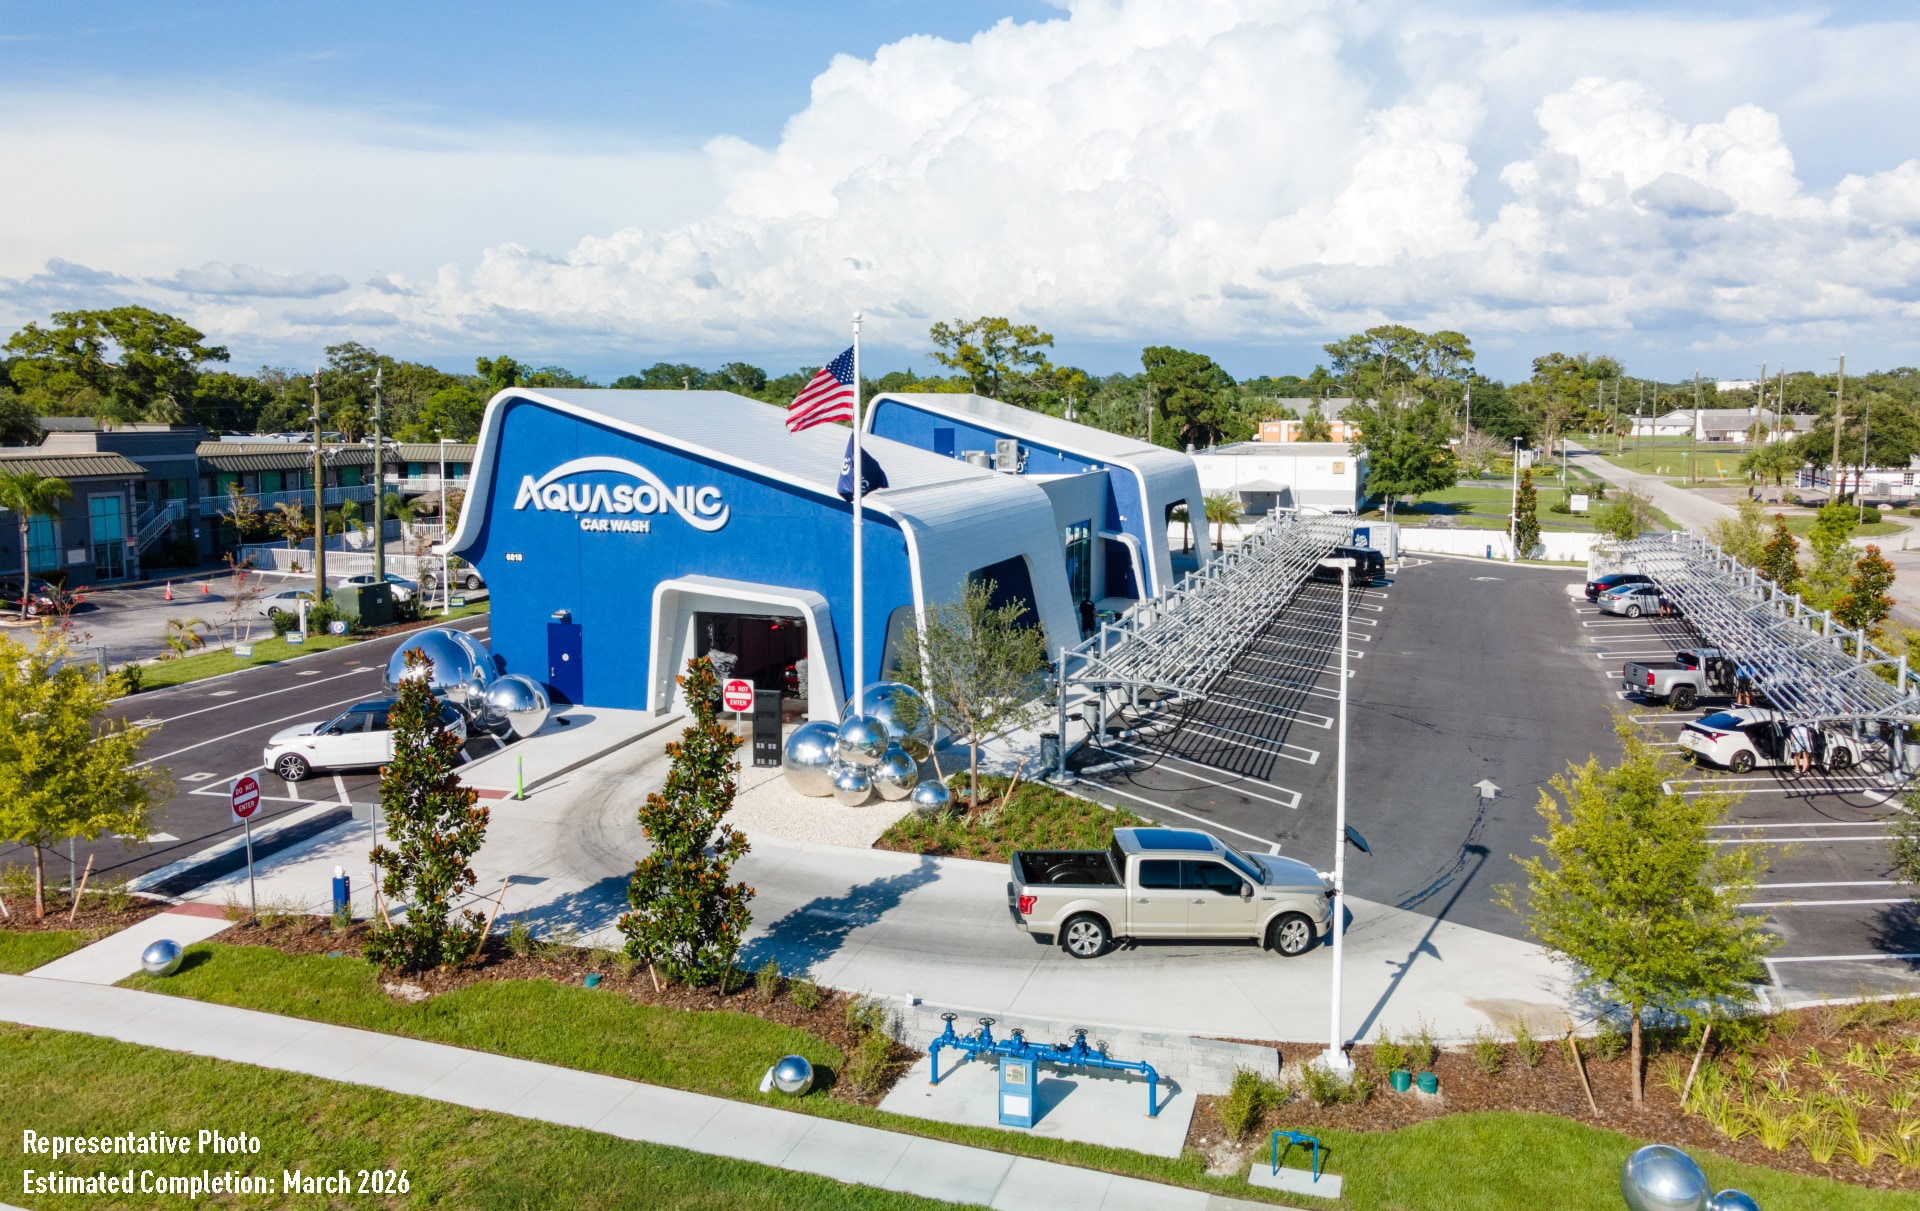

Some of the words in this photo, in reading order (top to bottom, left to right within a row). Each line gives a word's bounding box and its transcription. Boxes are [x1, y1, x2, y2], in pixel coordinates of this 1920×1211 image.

[514, 457, 730, 531] AQUASONIC
[580, 518, 608, 531] CAR
[610, 519, 649, 532] WASH
[236, 787, 243, 795] DO
[245, 782, 255, 791] NOT
[238, 800, 254, 812] ENTER
